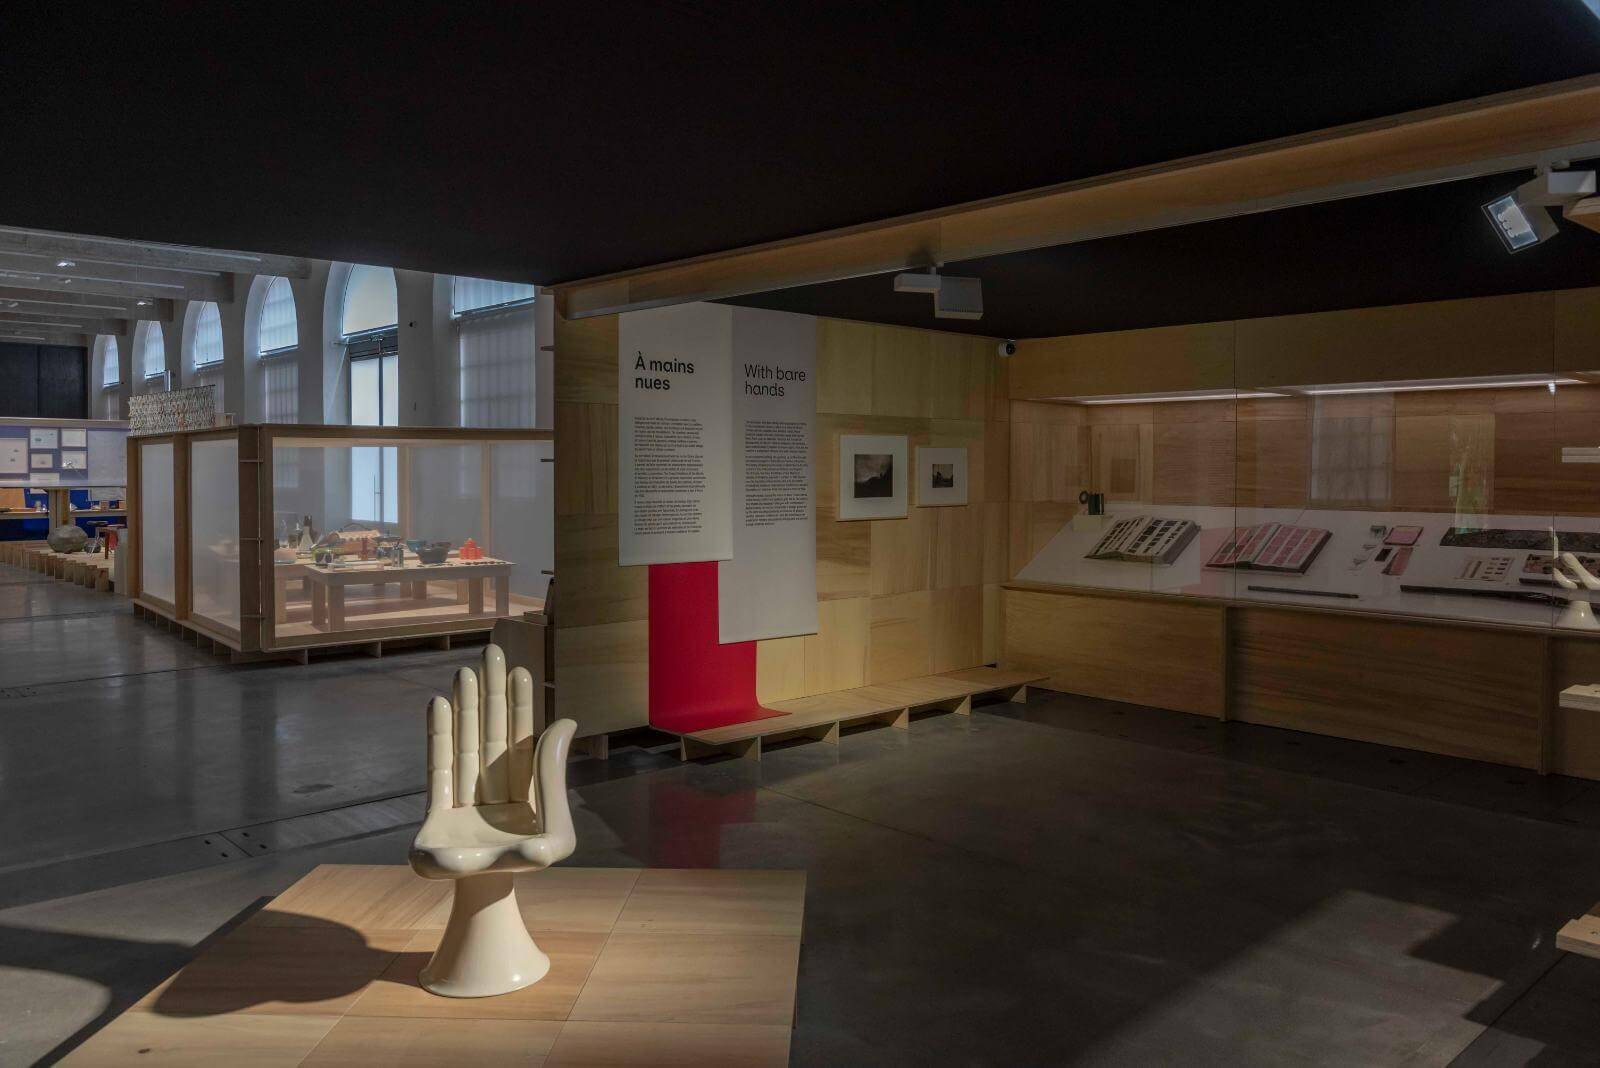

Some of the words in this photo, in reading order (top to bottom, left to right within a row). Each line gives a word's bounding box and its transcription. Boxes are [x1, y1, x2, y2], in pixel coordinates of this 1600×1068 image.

[635, 351, 646, 371] À
[650, 358, 695, 374] mains
[744, 363, 773, 380] With
[776, 366, 806, 382] bare
[635, 377, 671, 390] nues
[744, 381, 785, 397] hands
